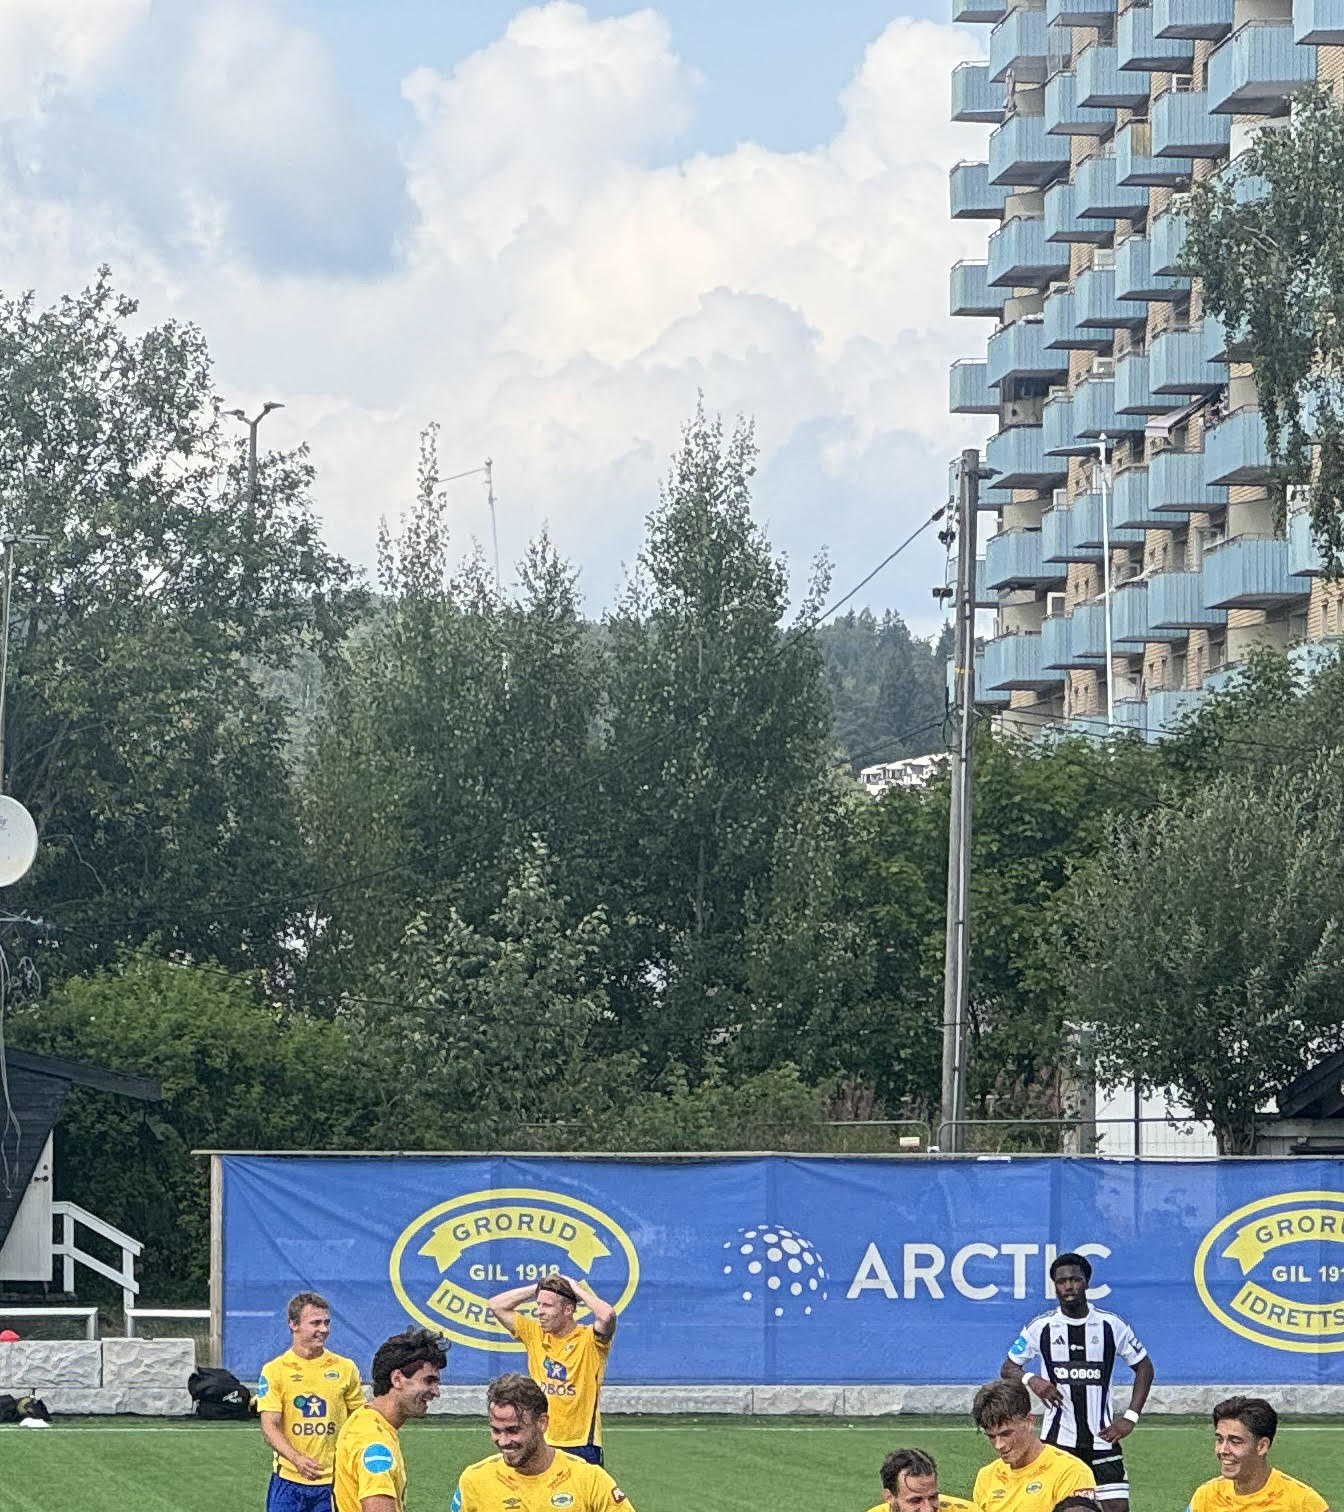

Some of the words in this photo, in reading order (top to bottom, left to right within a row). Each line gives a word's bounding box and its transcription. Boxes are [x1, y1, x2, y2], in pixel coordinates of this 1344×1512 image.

[452, 1213, 577, 1241] GRORUD
[469, 1264, 509, 1281] GIL
[516, 1264, 560, 1281] 1918
[846, 1242, 1112, 1300] ARCTIC
[1272, 1265, 1312, 1282] GIL
[1069, 1368, 1101, 1379] OBOS
[291, 1421, 336, 1436] OBOS
